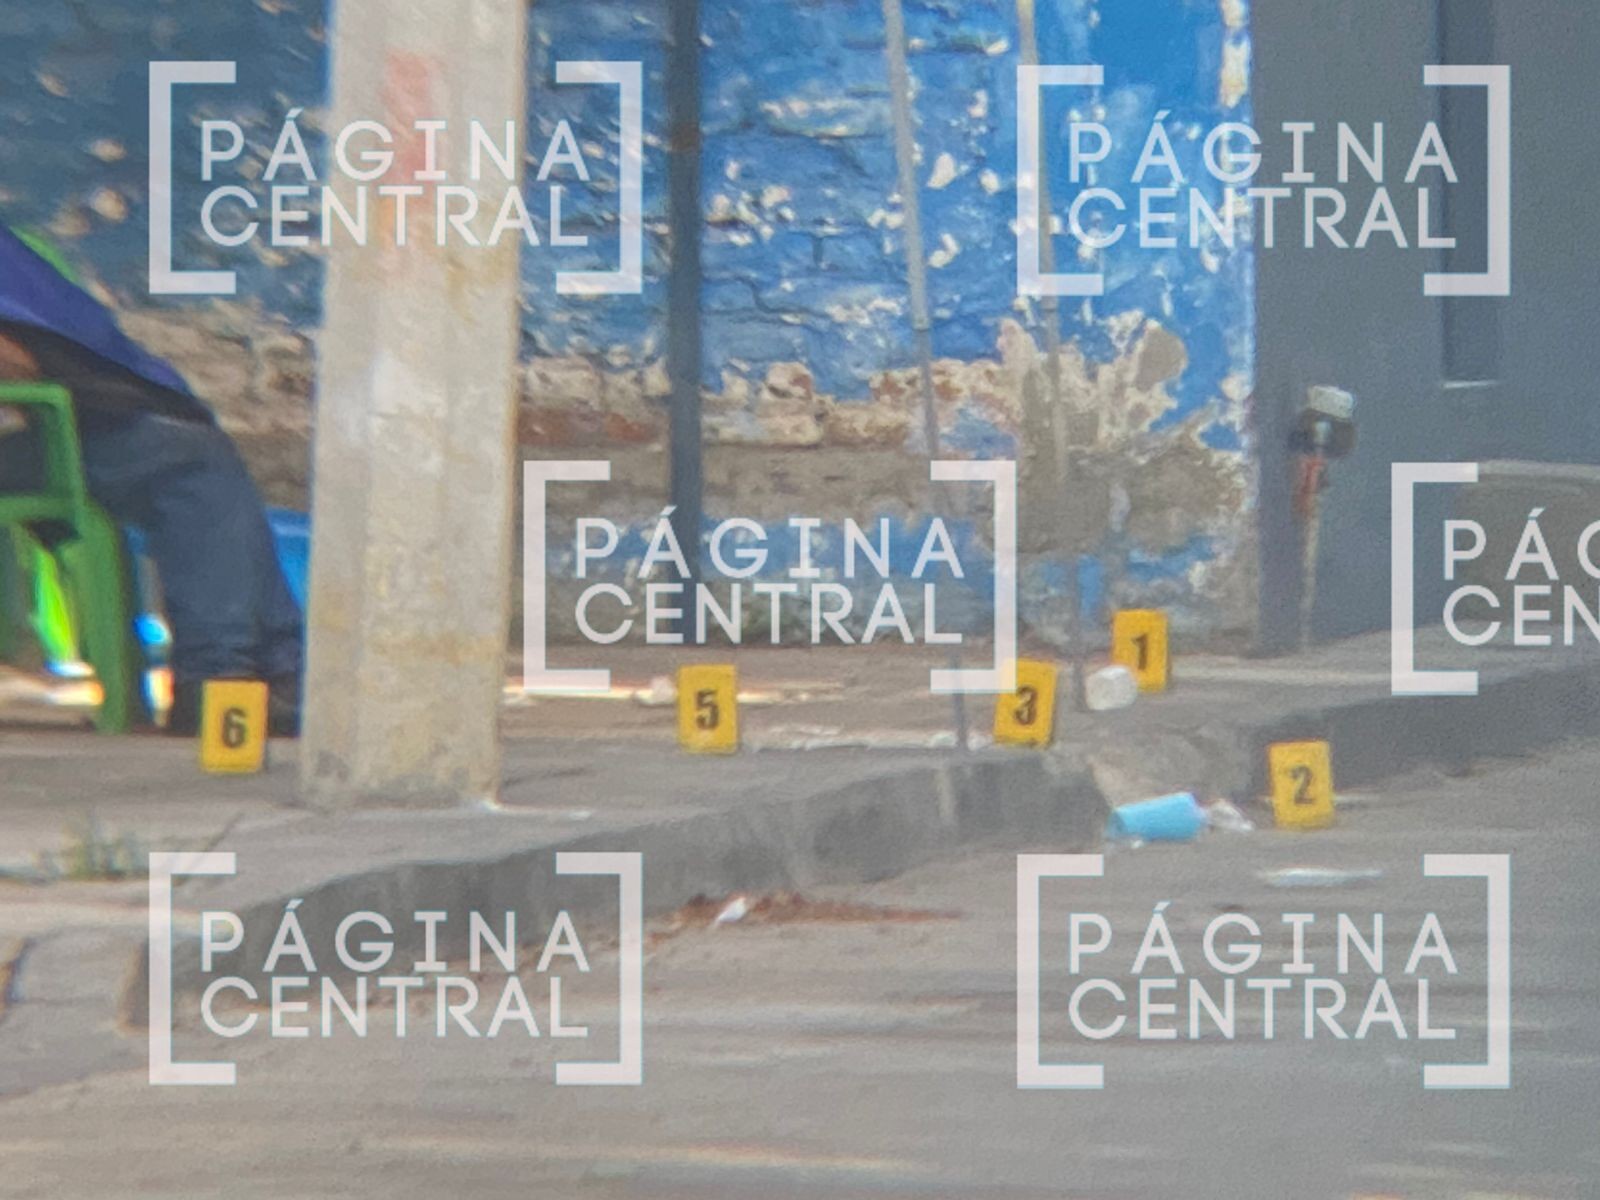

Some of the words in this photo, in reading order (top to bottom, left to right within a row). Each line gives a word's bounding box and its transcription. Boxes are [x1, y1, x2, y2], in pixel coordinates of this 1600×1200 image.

[1132, 634, 1148, 670] 1
[696, 688, 720, 731] 5
[1014, 687, 1037, 725] 3
[222, 707, 247, 749] 6
[1290, 766, 1314, 804] 2
